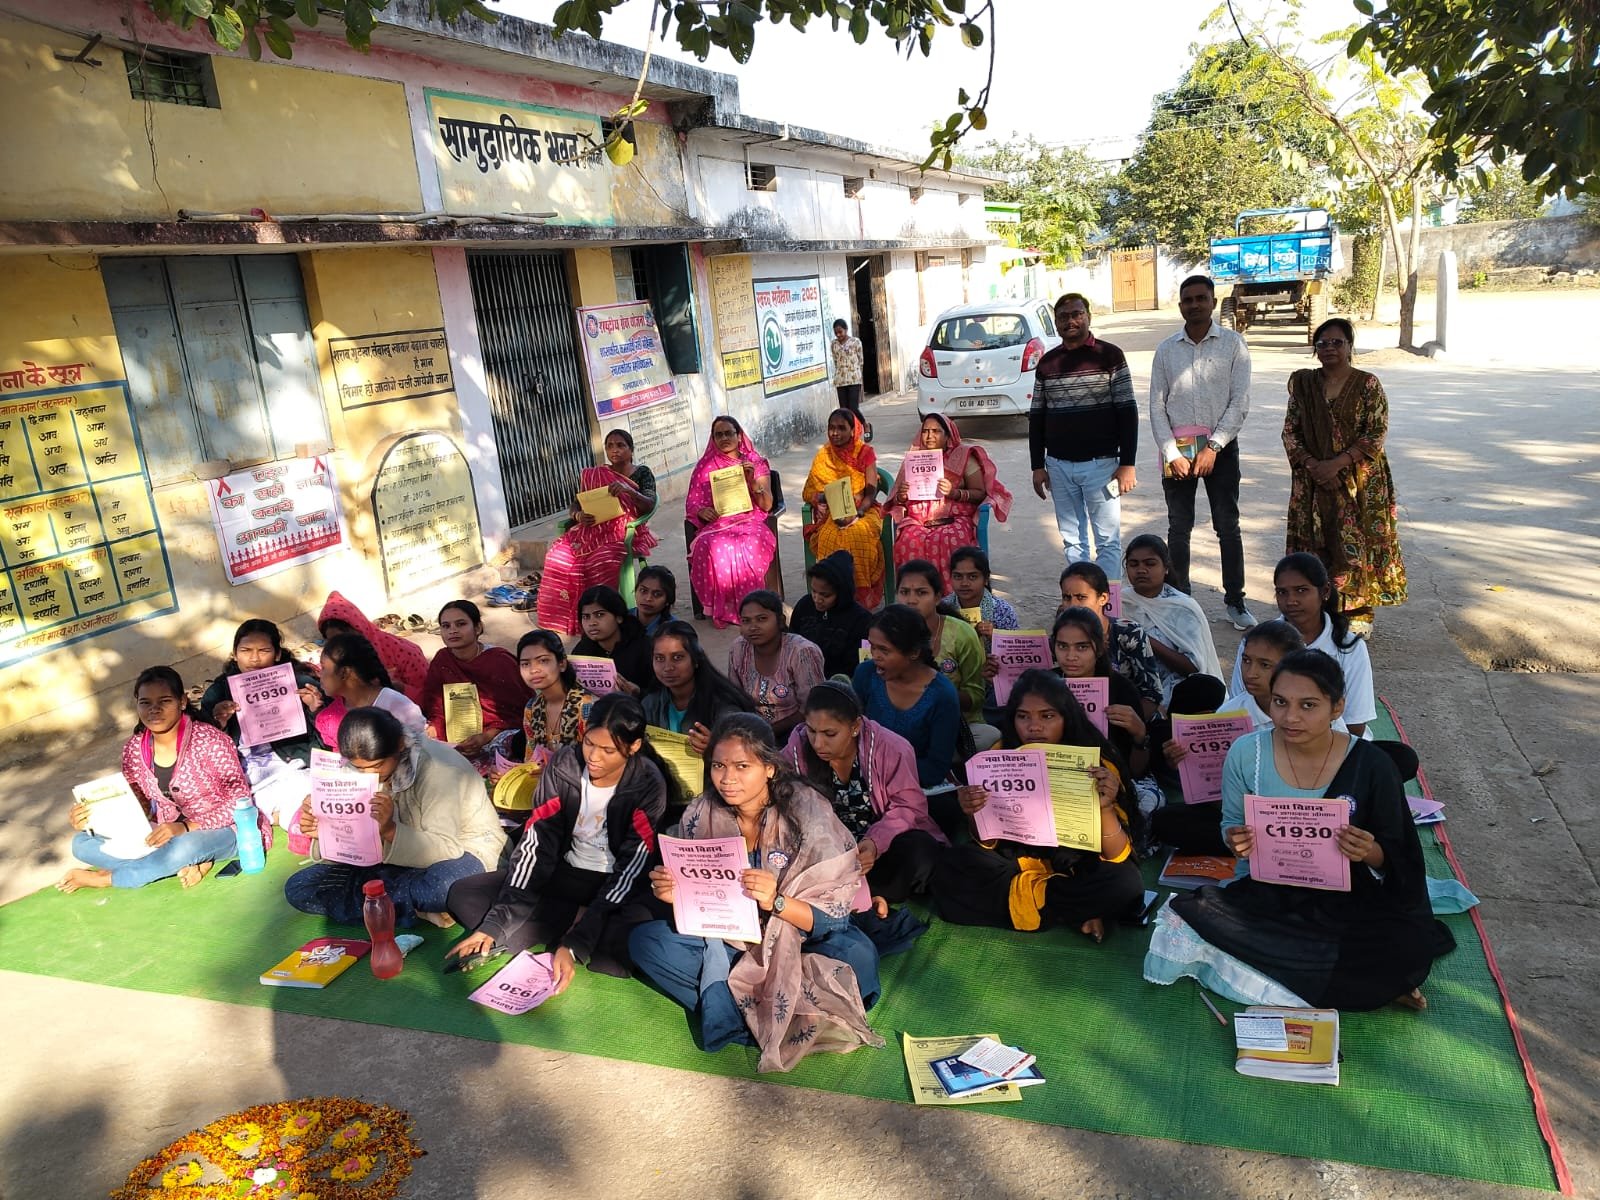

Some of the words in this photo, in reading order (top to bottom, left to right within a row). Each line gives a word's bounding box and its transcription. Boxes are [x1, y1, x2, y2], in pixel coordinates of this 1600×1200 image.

[438, 113, 541, 173] सामुदायिक
[544, 130, 580, 168] भवन
[801, 287, 818, 300] 2025
[23, 361, 47, 385] के
[398, 374, 413, 390] चली
[435, 373, 449, 384] जान
[916, 465, 937, 473] 1930
[1007, 655, 1042, 664] 1930
[583, 680, 612, 688] 1930
[253, 686, 288, 703] 1930
[1199, 740, 1231, 753] 193
[990, 778, 1036, 792] 1930
[327, 802, 365, 815] 1930
[1276, 825, 1333, 839] 1930
[689, 867, 736, 881] 1930
[499, 983, 539, 999] 1930
